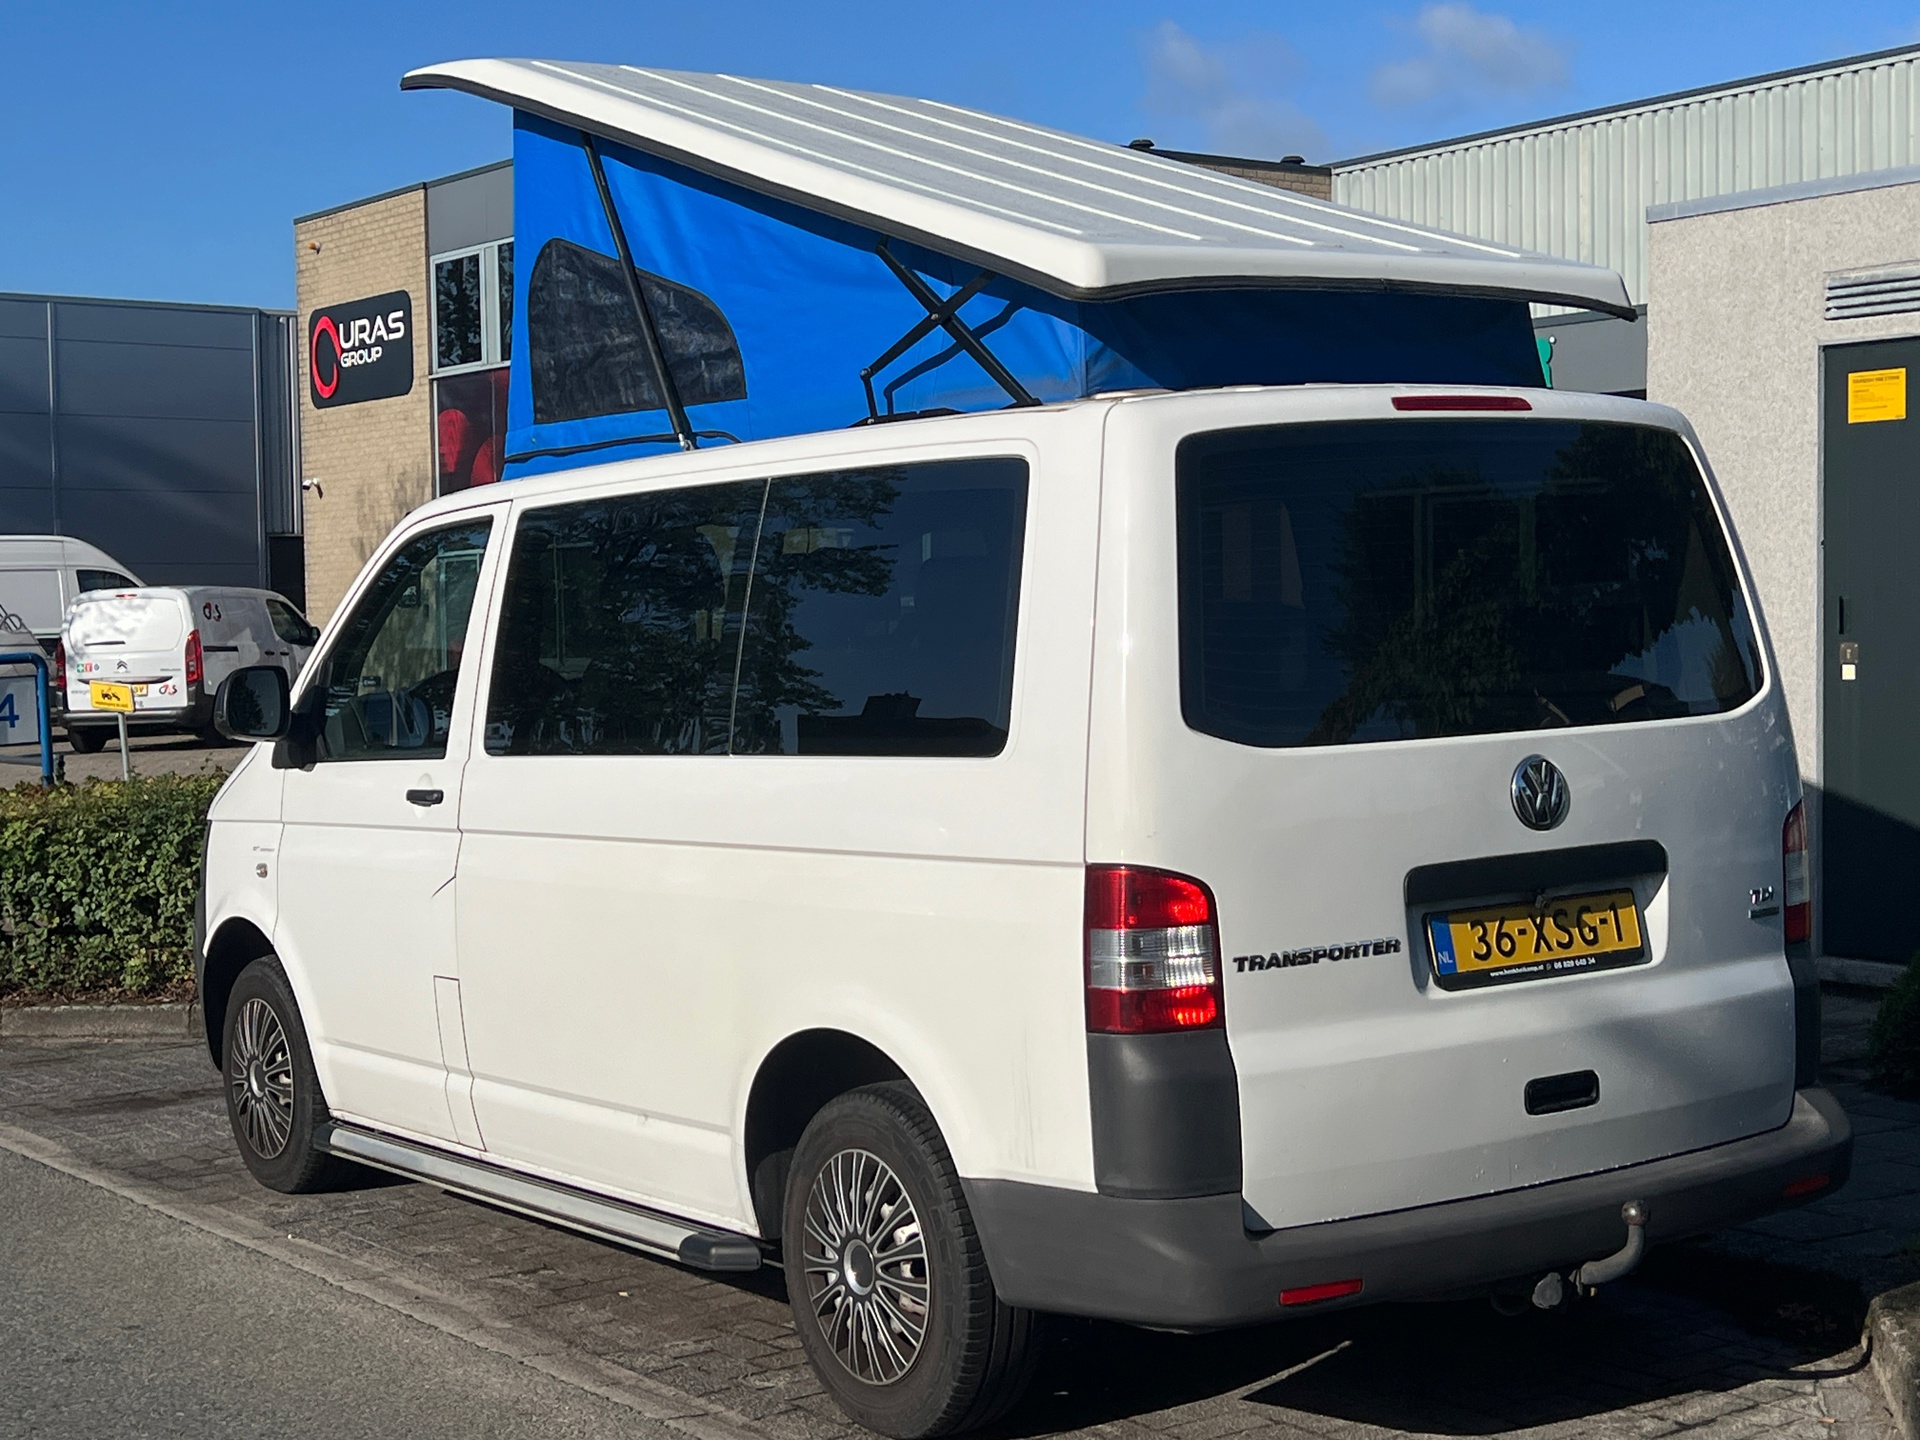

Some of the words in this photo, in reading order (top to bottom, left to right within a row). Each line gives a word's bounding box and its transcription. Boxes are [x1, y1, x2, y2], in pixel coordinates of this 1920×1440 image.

[341, 346, 383, 369] GROUP
[1468, 901, 1625, 962] 36-XSG-1
[1232, 936, 1402, 973] TRANSPORTER
[1437, 951, 1454, 965] NL
